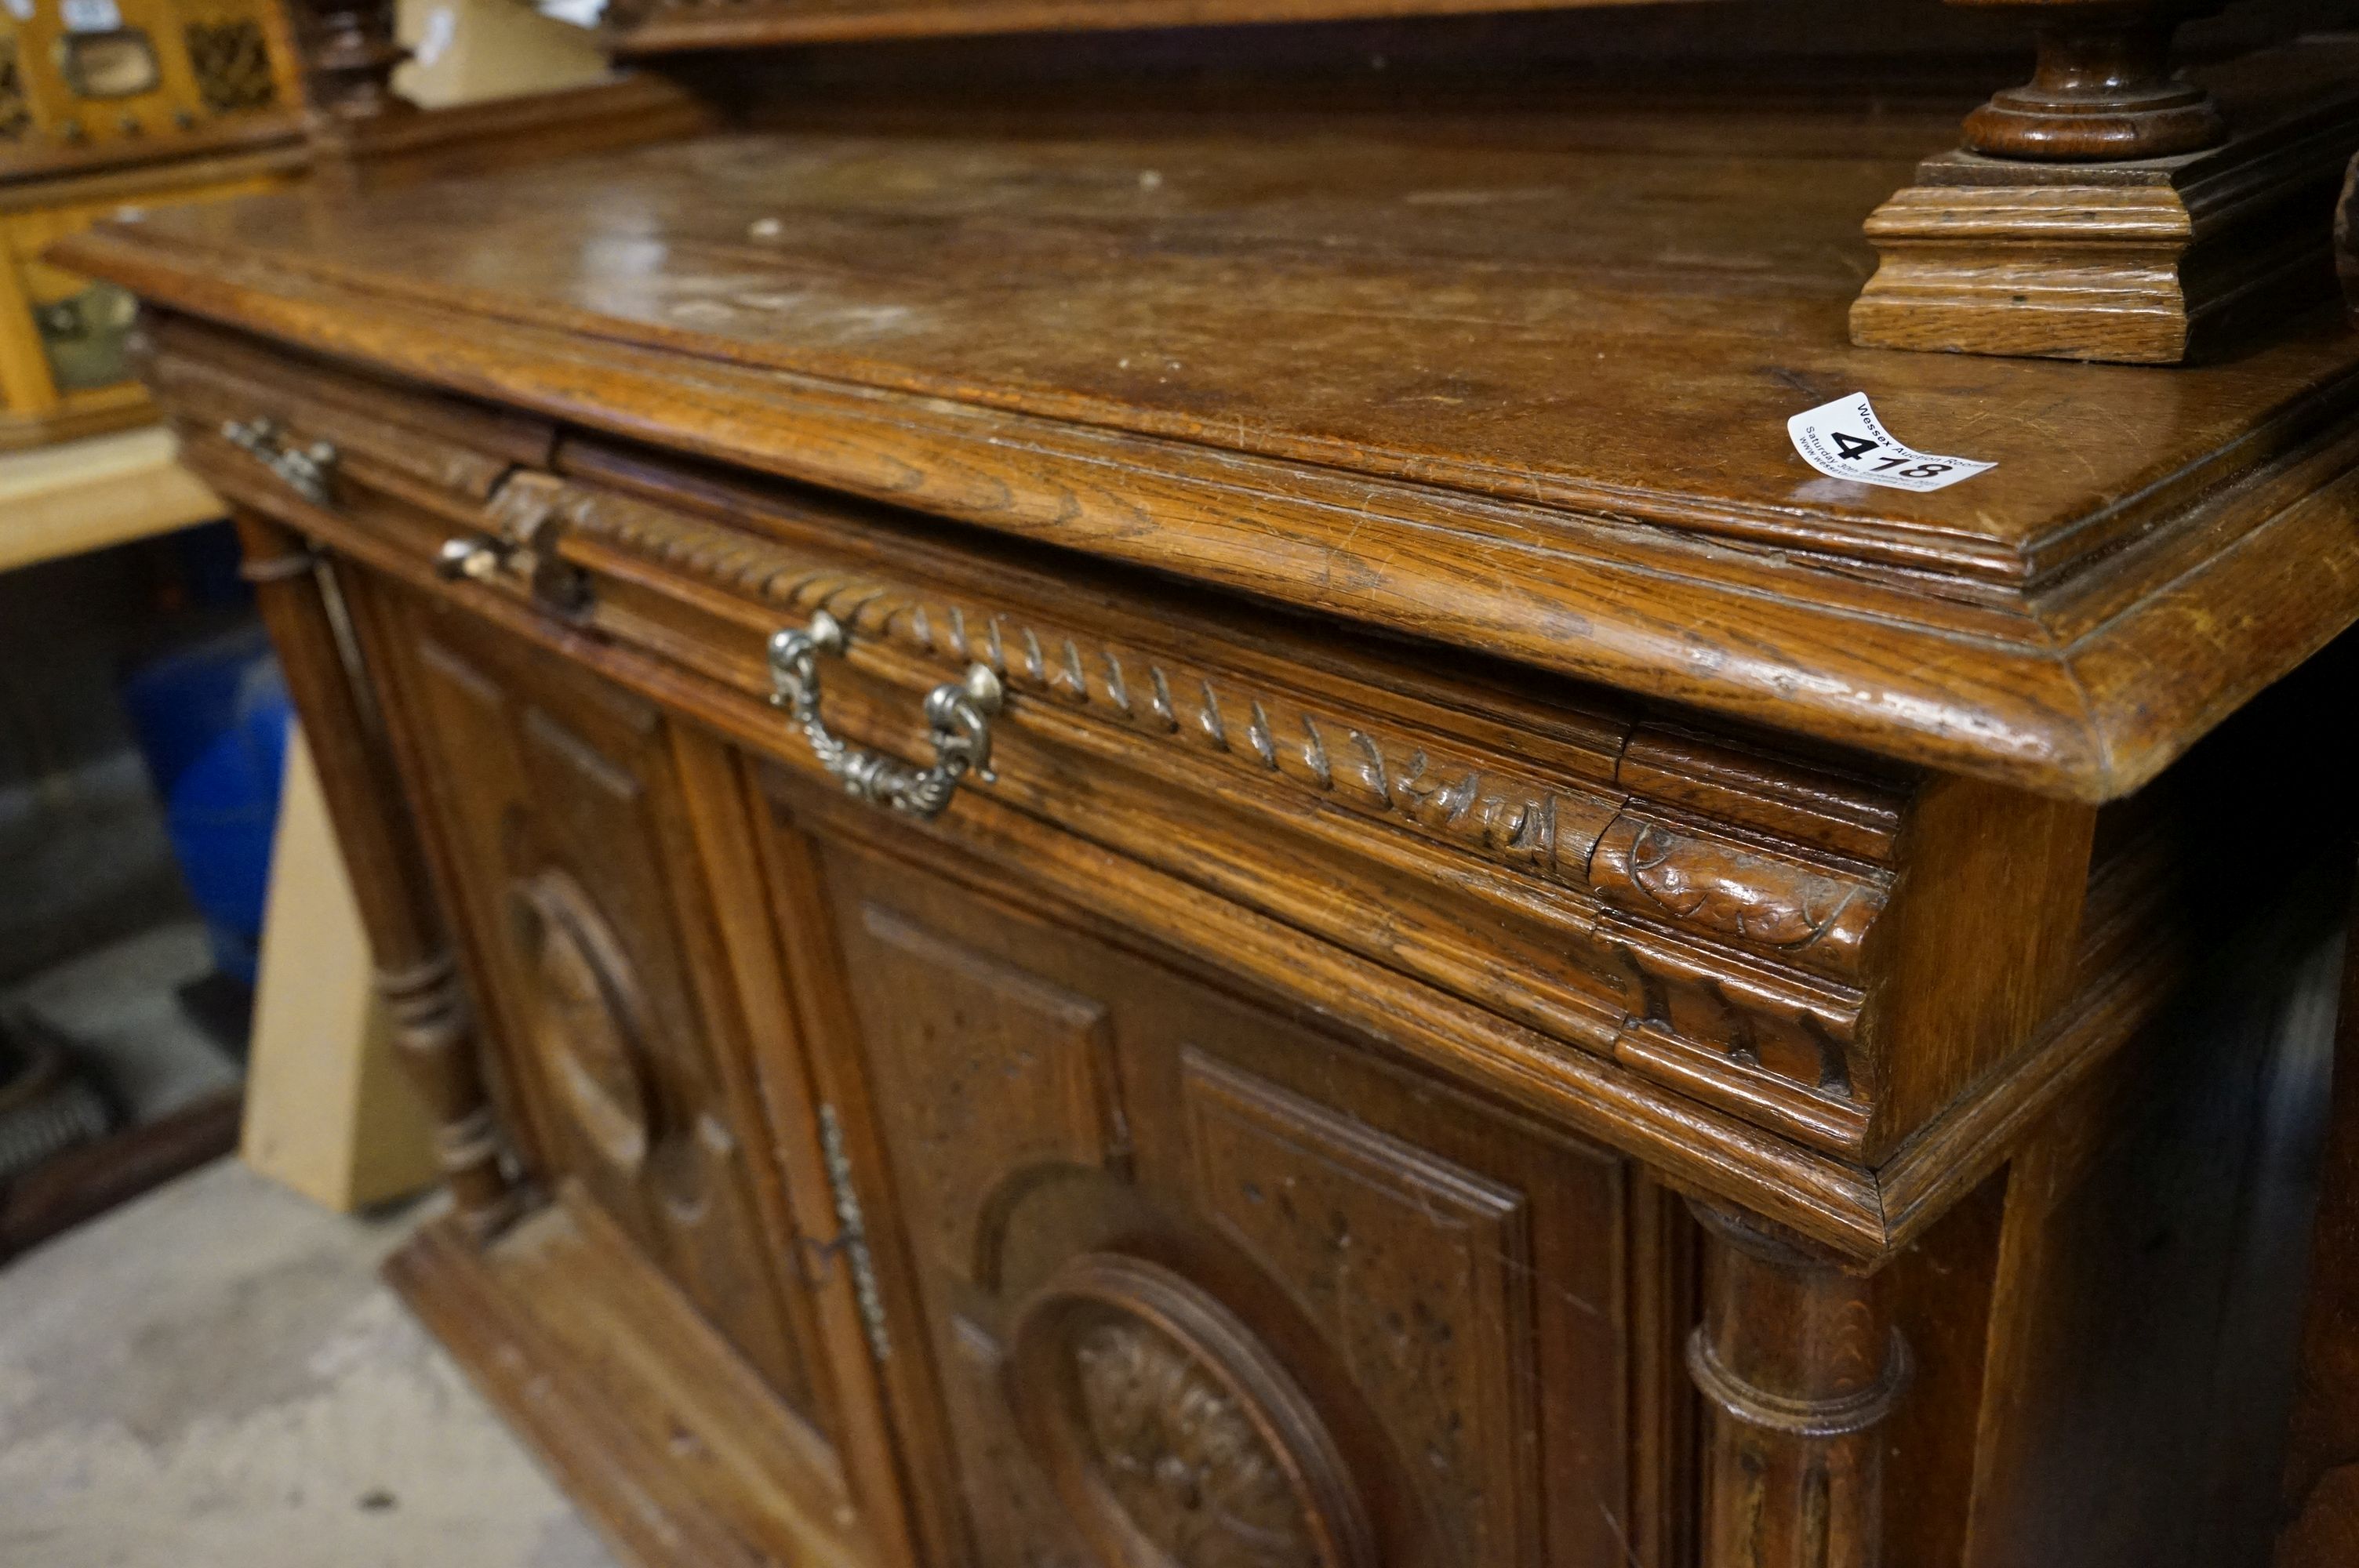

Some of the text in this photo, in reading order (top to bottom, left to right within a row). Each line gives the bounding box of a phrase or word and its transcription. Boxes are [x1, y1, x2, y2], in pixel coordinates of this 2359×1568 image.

[1806, 426, 1838, 463] Saturday
[1831, 431, 1953, 478] 418
[1857, 403, 1892, 447] Wessex
[1892, 447, 1941, 463] Auction
